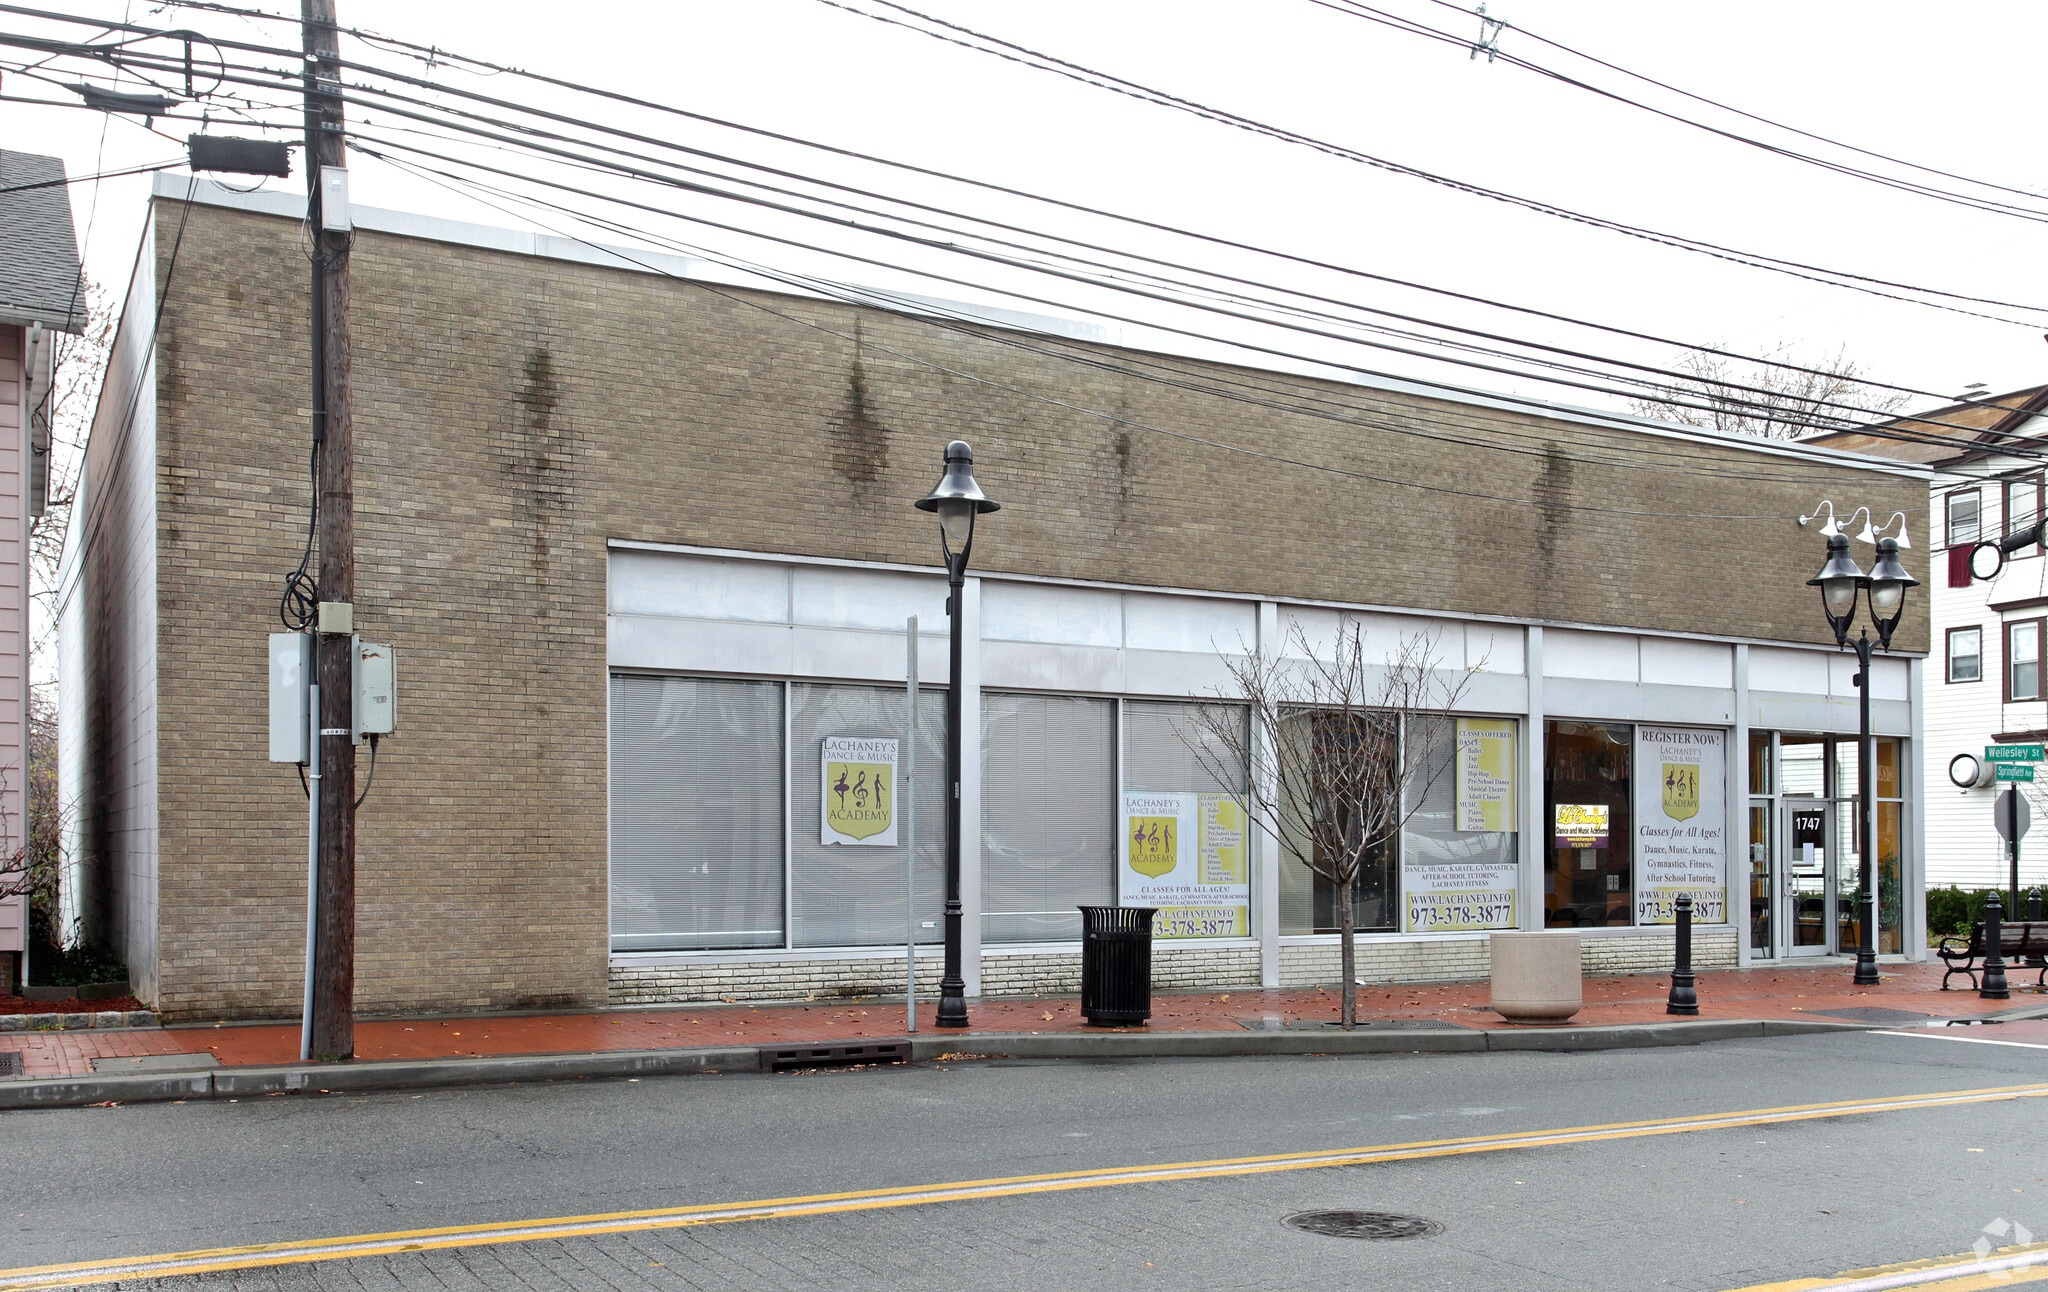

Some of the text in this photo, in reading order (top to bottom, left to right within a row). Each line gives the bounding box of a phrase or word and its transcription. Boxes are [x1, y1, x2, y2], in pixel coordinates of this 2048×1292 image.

[1642, 730, 1719, 746] REGISTER NOW!
[824, 740, 896, 753] LACHANEY'S
[1660, 745, 1702, 756] LACHANEY'S
[823, 750, 897, 762] DANCE & MUSIC
[1988, 746, 2040, 760] Wellesley St
[1998, 765, 2025, 779] Springfield
[1126, 797, 1180, 807] LACHANEY'S
[1663, 799, 1698, 808] ACADEMY
[829, 809, 889, 821] ACADEMY
[1126, 807, 1149, 815] DANCE
[1795, 817, 1820, 831] 1747
[1569, 826, 1578, 835] and
[1578, 826, 1590, 835] Music
[1640, 825, 1721, 840] Classes for All Ages!
[1644, 844, 1717, 855] Dance, Music, Karate,
[1131, 854, 1175, 863] ACADEMY
[1647, 858, 1714, 870] Gymnastics, Fitness,
[1432, 880, 1464, 888] LACHANEY
[1645, 873, 1716, 884] After School Tutoring
[1410, 893, 1511, 905] WWW.LACHANEY.INFO
[1639, 890, 1723, 900] WWW.LACHNEY.INFO
[1155, 909, 1234, 919] W.LACHANEY.INFO
[1411, 904, 1511, 926] 973-378-3877
[1639, 901, 1723, 919] 973-33877
[1152, 919, 1234, 936] 3-378-3877
